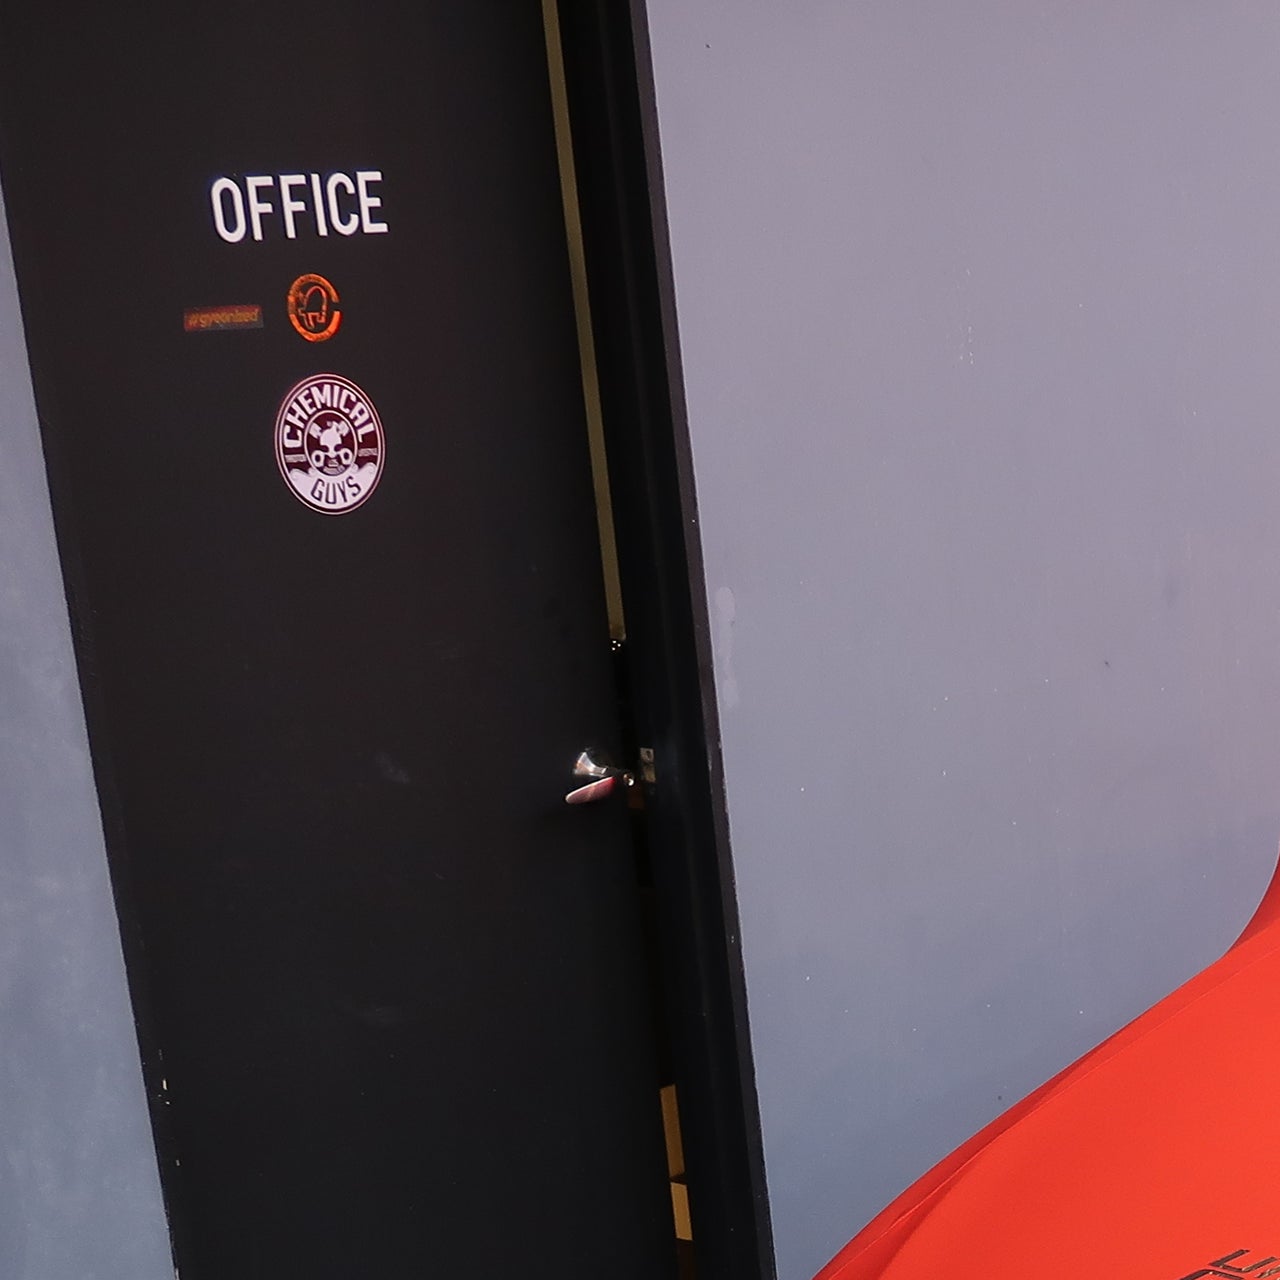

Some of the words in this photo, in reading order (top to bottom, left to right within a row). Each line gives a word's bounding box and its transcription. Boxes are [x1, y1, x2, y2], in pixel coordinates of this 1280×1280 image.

[210, 171, 389, 243] OFFICE
[283, 384, 375, 448] CHEMICAL
[311, 476, 361, 504] GUYS
